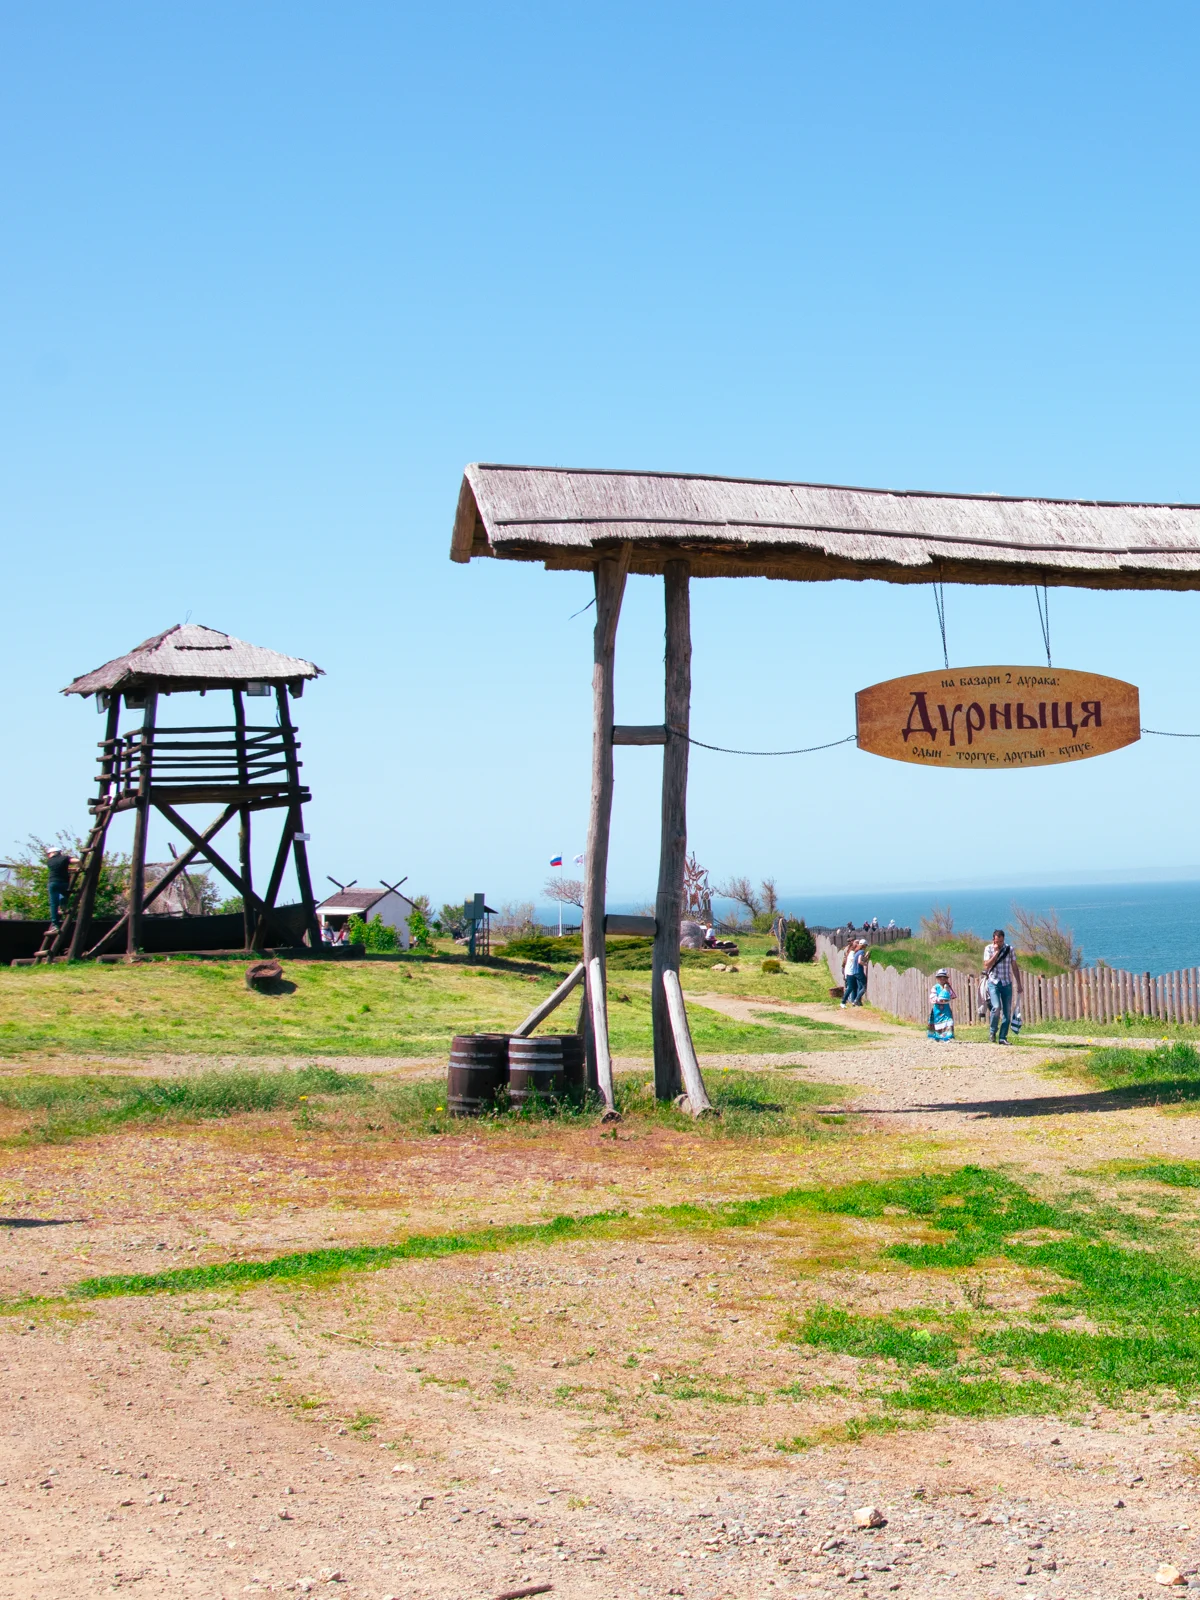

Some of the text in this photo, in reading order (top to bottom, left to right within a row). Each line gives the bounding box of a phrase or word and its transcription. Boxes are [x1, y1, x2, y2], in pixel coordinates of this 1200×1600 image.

[941, 679, 955, 688] на
[1005, 672, 1012, 684] 2
[1016, 675, 1060, 688] дурака:
[901, 691, 1102, 746] Дурныця
[912, 746, 942, 759] одын
[1003, 747, 1046, 763] другый
